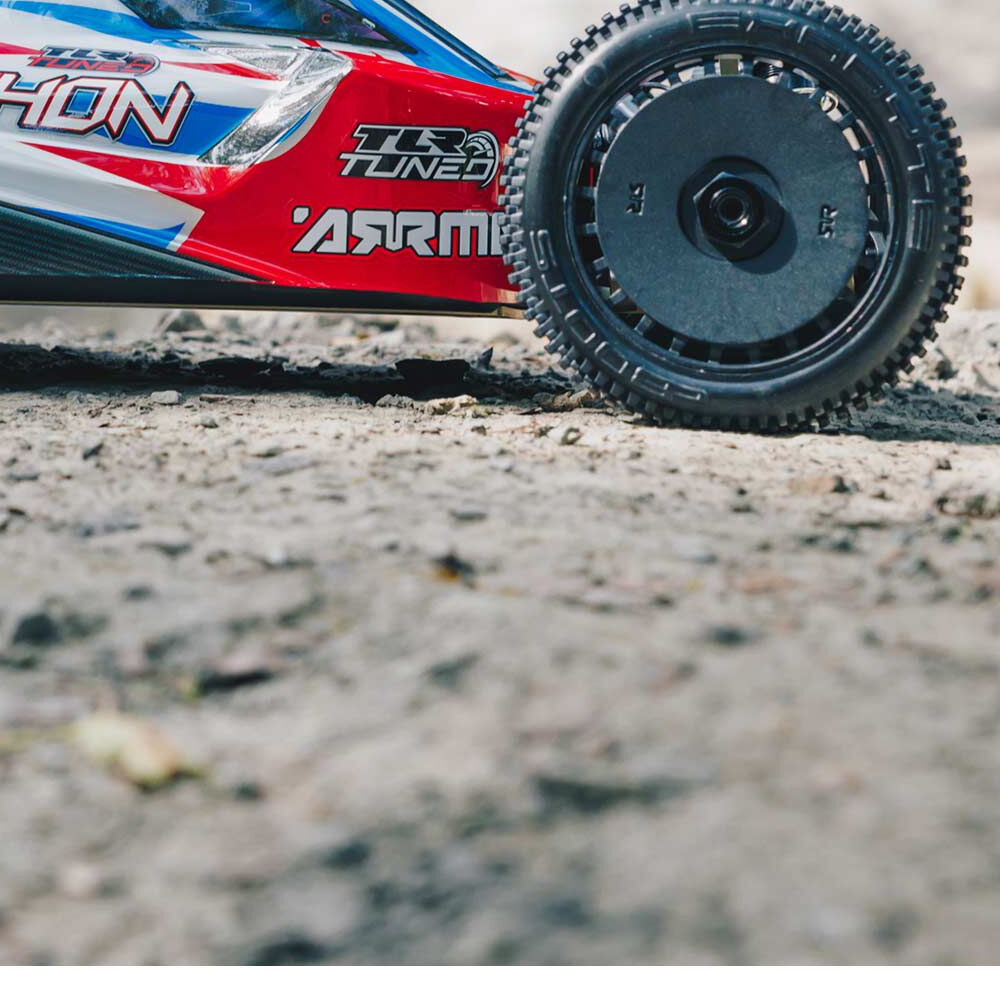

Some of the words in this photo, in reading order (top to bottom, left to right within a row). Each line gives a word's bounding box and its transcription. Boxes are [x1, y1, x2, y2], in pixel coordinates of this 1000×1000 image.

[27, 56, 153, 74] TUNED
[353, 125, 469, 156] TLR
[340, 153, 496, 181] TUNED
[292, 207, 506, 257] ARRM
